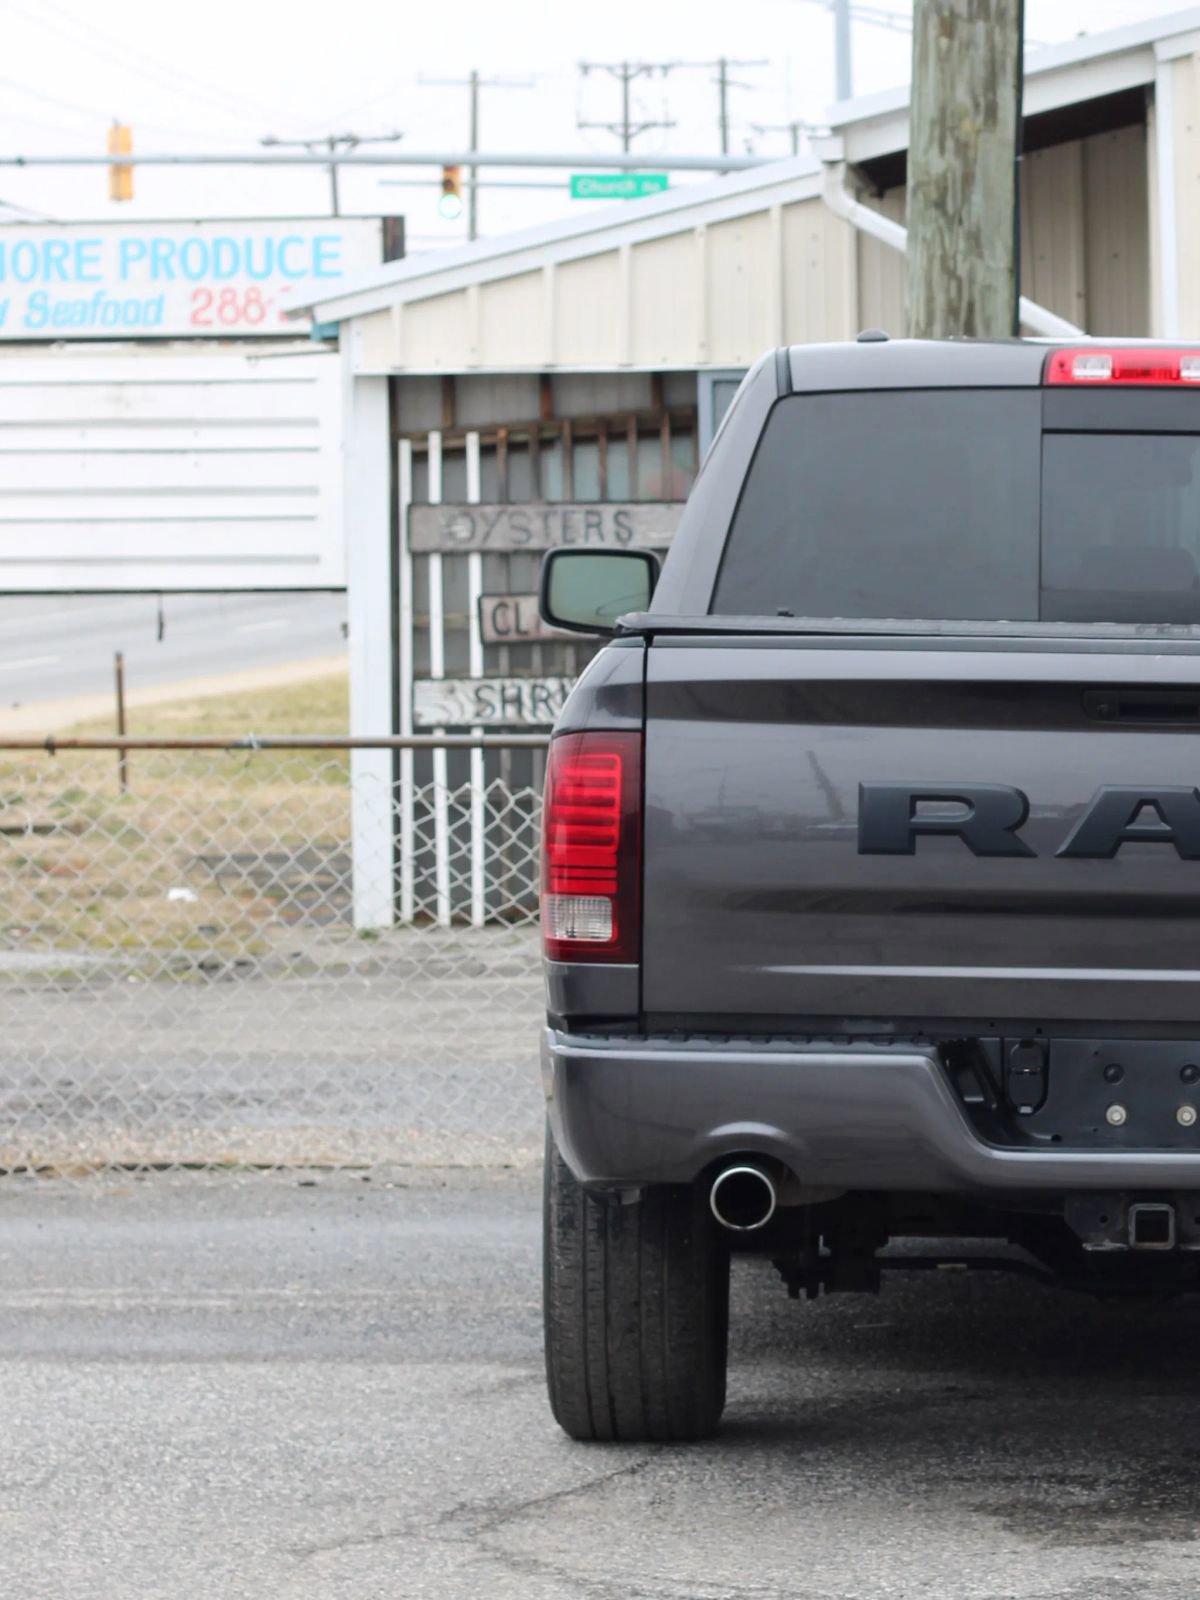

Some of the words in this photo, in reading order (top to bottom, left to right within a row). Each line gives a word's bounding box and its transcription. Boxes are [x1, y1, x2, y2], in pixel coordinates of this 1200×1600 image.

[0, 238, 104, 283] ORE
[118, 234, 344, 281] PRODUCE
[23, 288, 165, 329] Seafood
[446, 509, 634, 545] OYSTERS
[491, 601, 541, 636] CL
